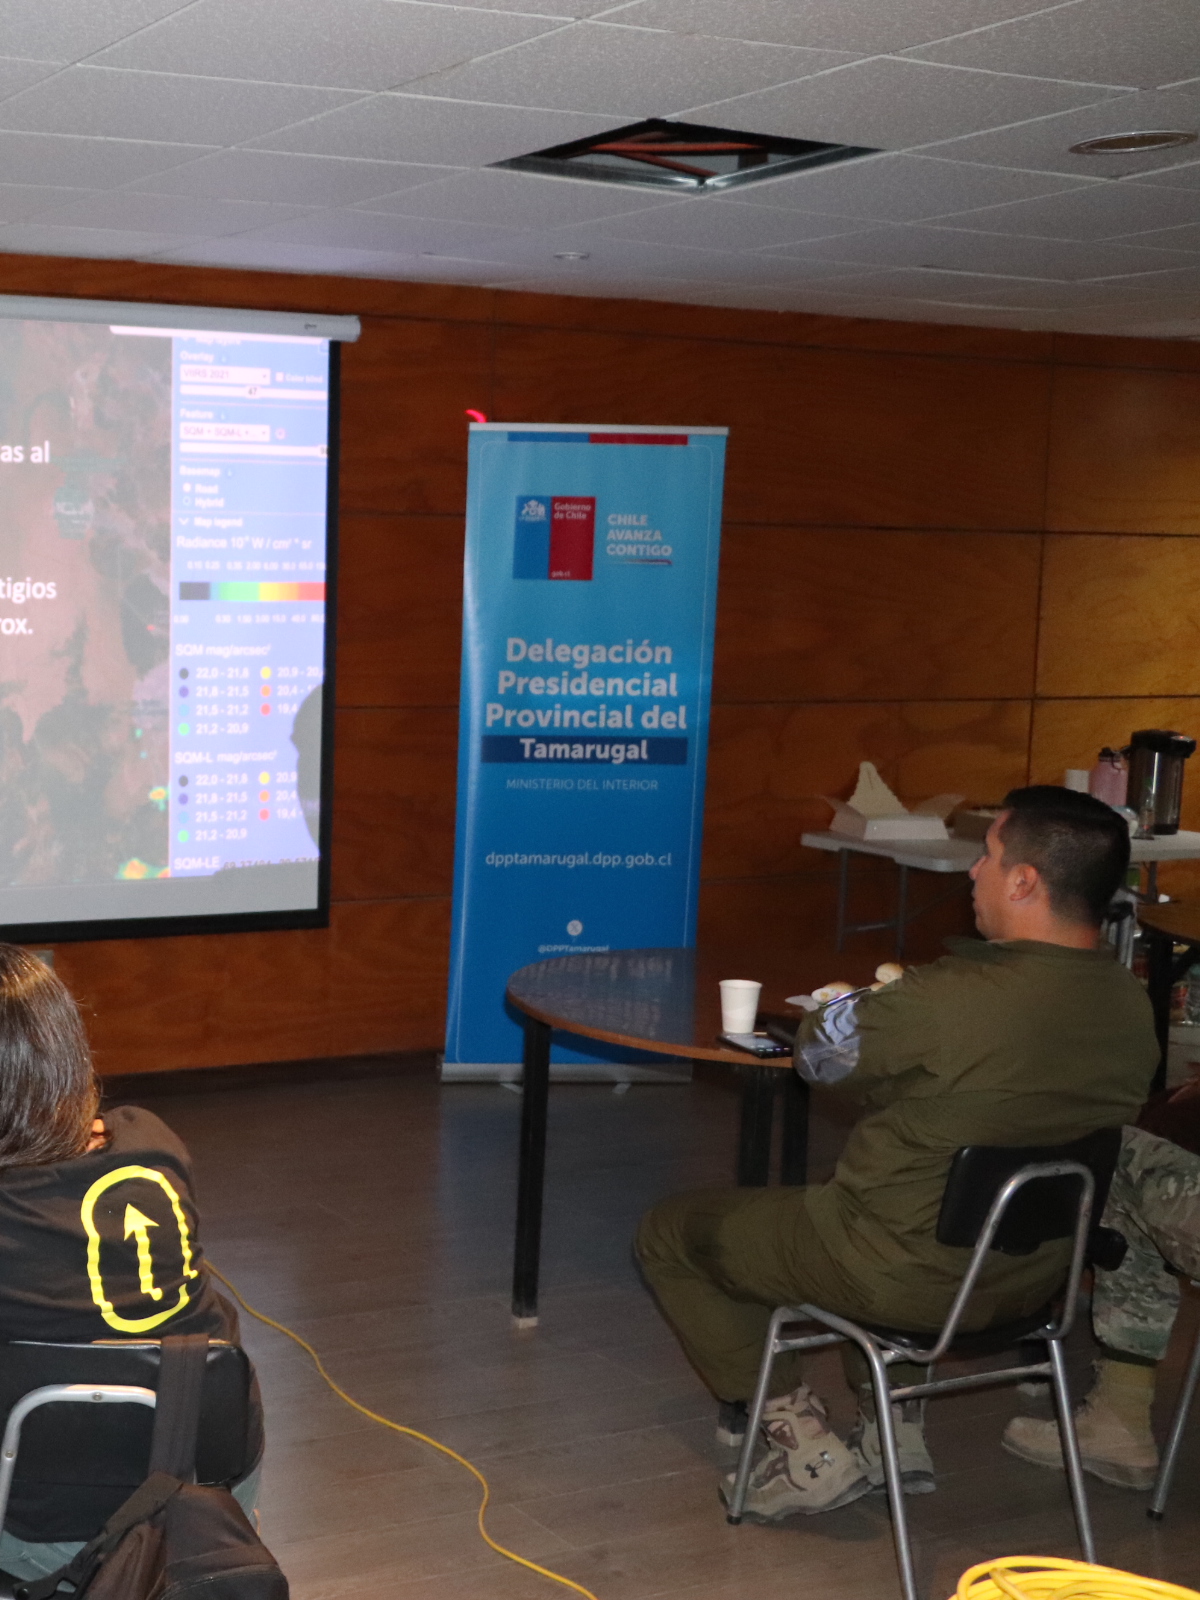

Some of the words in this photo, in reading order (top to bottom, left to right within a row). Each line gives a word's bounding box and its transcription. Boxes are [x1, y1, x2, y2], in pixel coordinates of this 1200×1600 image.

[180, 351, 214, 363] Overlay
[210, 369, 229, 379] 2021
[248, 387, 257, 395] 47
[180, 408, 213, 419] Feature
[184, 426, 204, 436] SQM
[30, 440, 50, 463] al
[554, 502, 591, 512] Gobierno
[554, 511, 564, 520] de
[566, 511, 587, 520] Chile
[607, 514, 648, 526] CHILE
[606, 530, 663, 541] AVANZA
[176, 536, 227, 548] Radiance
[252, 537, 264, 549] W
[606, 544, 673, 556] CONTIGO
[175, 644, 203, 656] SQM
[506, 637, 673, 669] Delegación
[497, 670, 678, 697] Presidencial
[485, 702, 634, 728] Provincial
[641, 704, 687, 729] del
[519, 738, 648, 764] Tamarugal
[174, 751, 213, 764] SQM-L
[506, 778, 574, 790] MINISTERIO
[577, 779, 599, 790] DEL
[603, 780, 659, 791] INTERIOR
[174, 856, 220, 870] SQM-LE
[485, 851, 672, 868] dpptamarugal.dpp.gob.cl
